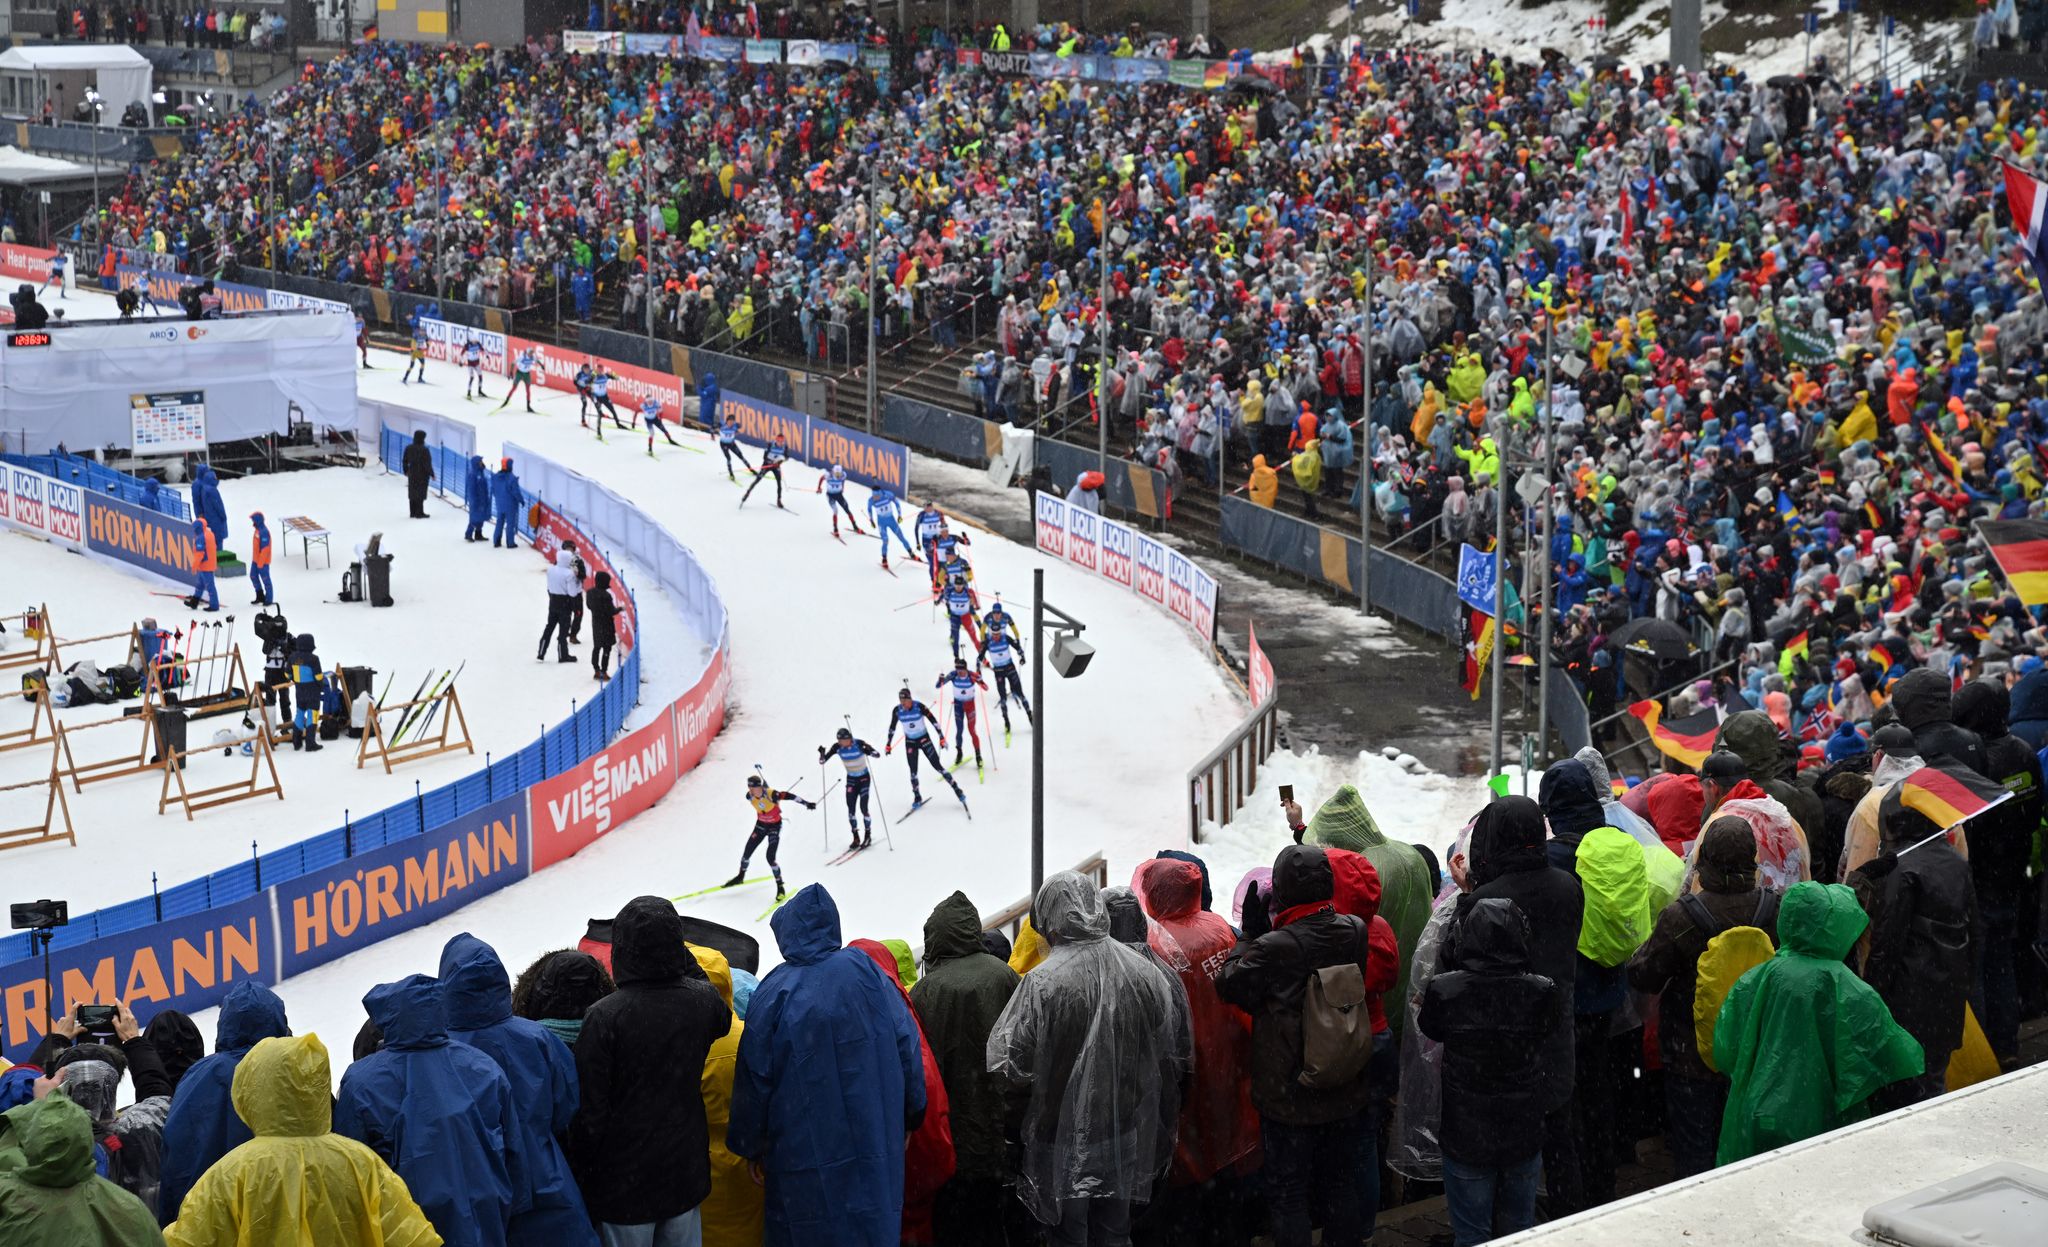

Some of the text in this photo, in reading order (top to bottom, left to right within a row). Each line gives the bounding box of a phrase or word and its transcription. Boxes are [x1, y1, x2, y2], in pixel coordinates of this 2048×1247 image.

[7, 249, 27, 267] Heat
[723, 400, 803, 453] HÖRMANN
[813, 428, 901, 486] HÖRMANN
[14, 472, 42, 502] LIQUI
[49, 483, 78, 514] LIQUI
[16, 498, 43, 527] MOLY
[50, 509, 79, 539] MOLY
[1039, 496, 1064, 528] LIQUI
[1071, 508, 1096, 543] LIQUI
[90, 504, 197, 575] HÖRMANN
[1039, 522, 1064, 554] MOLY
[1070, 535, 1096, 568] MOLY
[1103, 521, 1130, 558] LIQUI
[1138, 538, 1163, 574] LIQUI
[1103, 549, 1131, 586] MOLY
[1138, 565, 1163, 602] MOLY
[1169, 553, 1192, 592] LIQUI
[1169, 582, 1192, 621] MOLY
[547, 753, 668, 834] VIESSMANN
[293, 813, 518, 954] HÖRMANN
[0, 916, 260, 1047] RMANN
